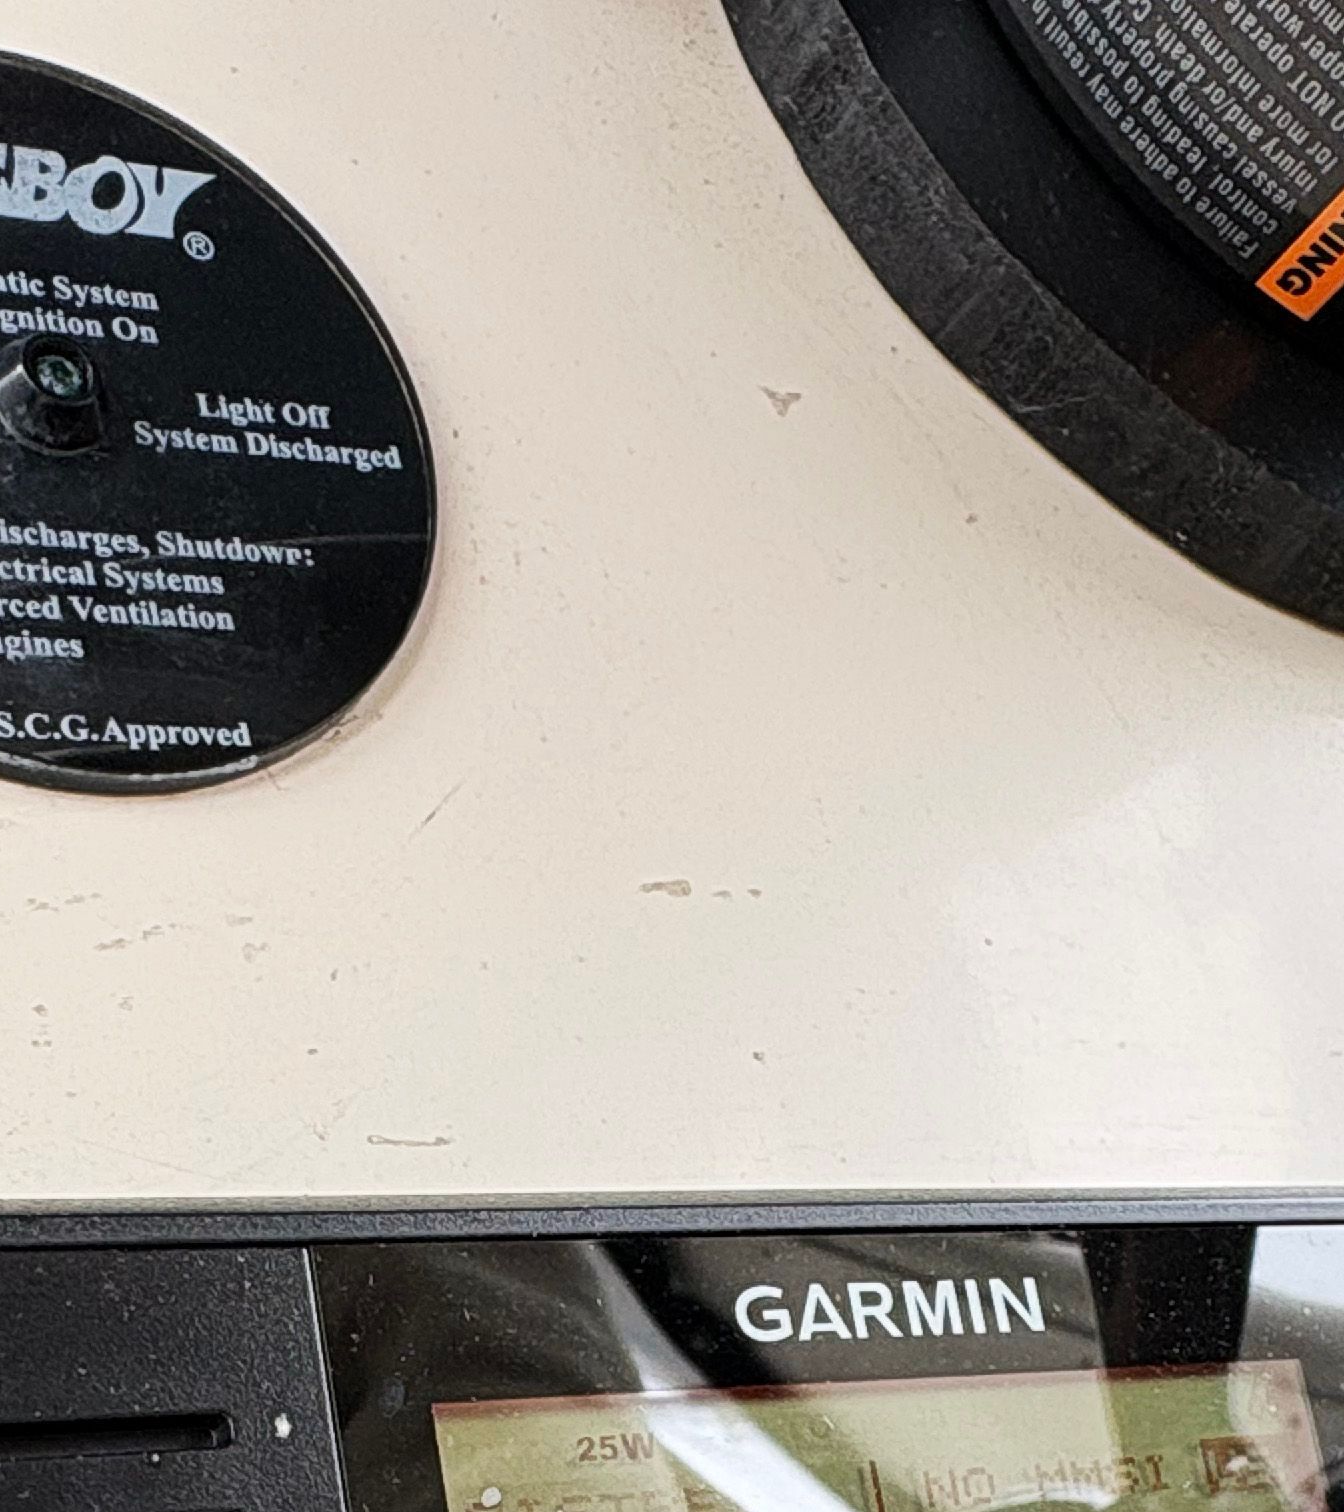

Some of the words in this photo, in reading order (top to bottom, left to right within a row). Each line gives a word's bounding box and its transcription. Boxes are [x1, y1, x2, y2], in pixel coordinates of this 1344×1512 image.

[1043, 15, 1091, 78] result
[1170, 0, 1261, 102] informatio
[1086, 72, 1123, 119] may
[1124, 76, 1145, 104] to
[1201, 80, 1264, 143] and/or
[1286, 70, 1336, 117] NOT
[1141, 95, 1208, 174] leading
[1168, 81, 1238, 159] causing
[1257, 93, 1310, 146] more
[1119, 115, 1180, 181] adhere
[1259, 136, 1318, 197] injury
[1305, 140, 1339, 175] for
[1176, 176, 1198, 204] to
[1232, 155, 1298, 215] vessel
[1195, 196, 1260, 260] Failure
[52, 274, 159, 311] System
[112, 317, 159, 345] On
[195, 393, 276, 427] Light
[282, 401, 331, 429] Off
[133, 420, 239, 453] System
[245, 431, 403, 473] Discharged
[155, 531, 314, 567] Shutdown:
[104, 563, 225, 595] Systems
[68, 596, 235, 632] Ventilation
[735, 1277, 1045, 1344] GARMIN
[576, 1432, 654, 1463] 25W
